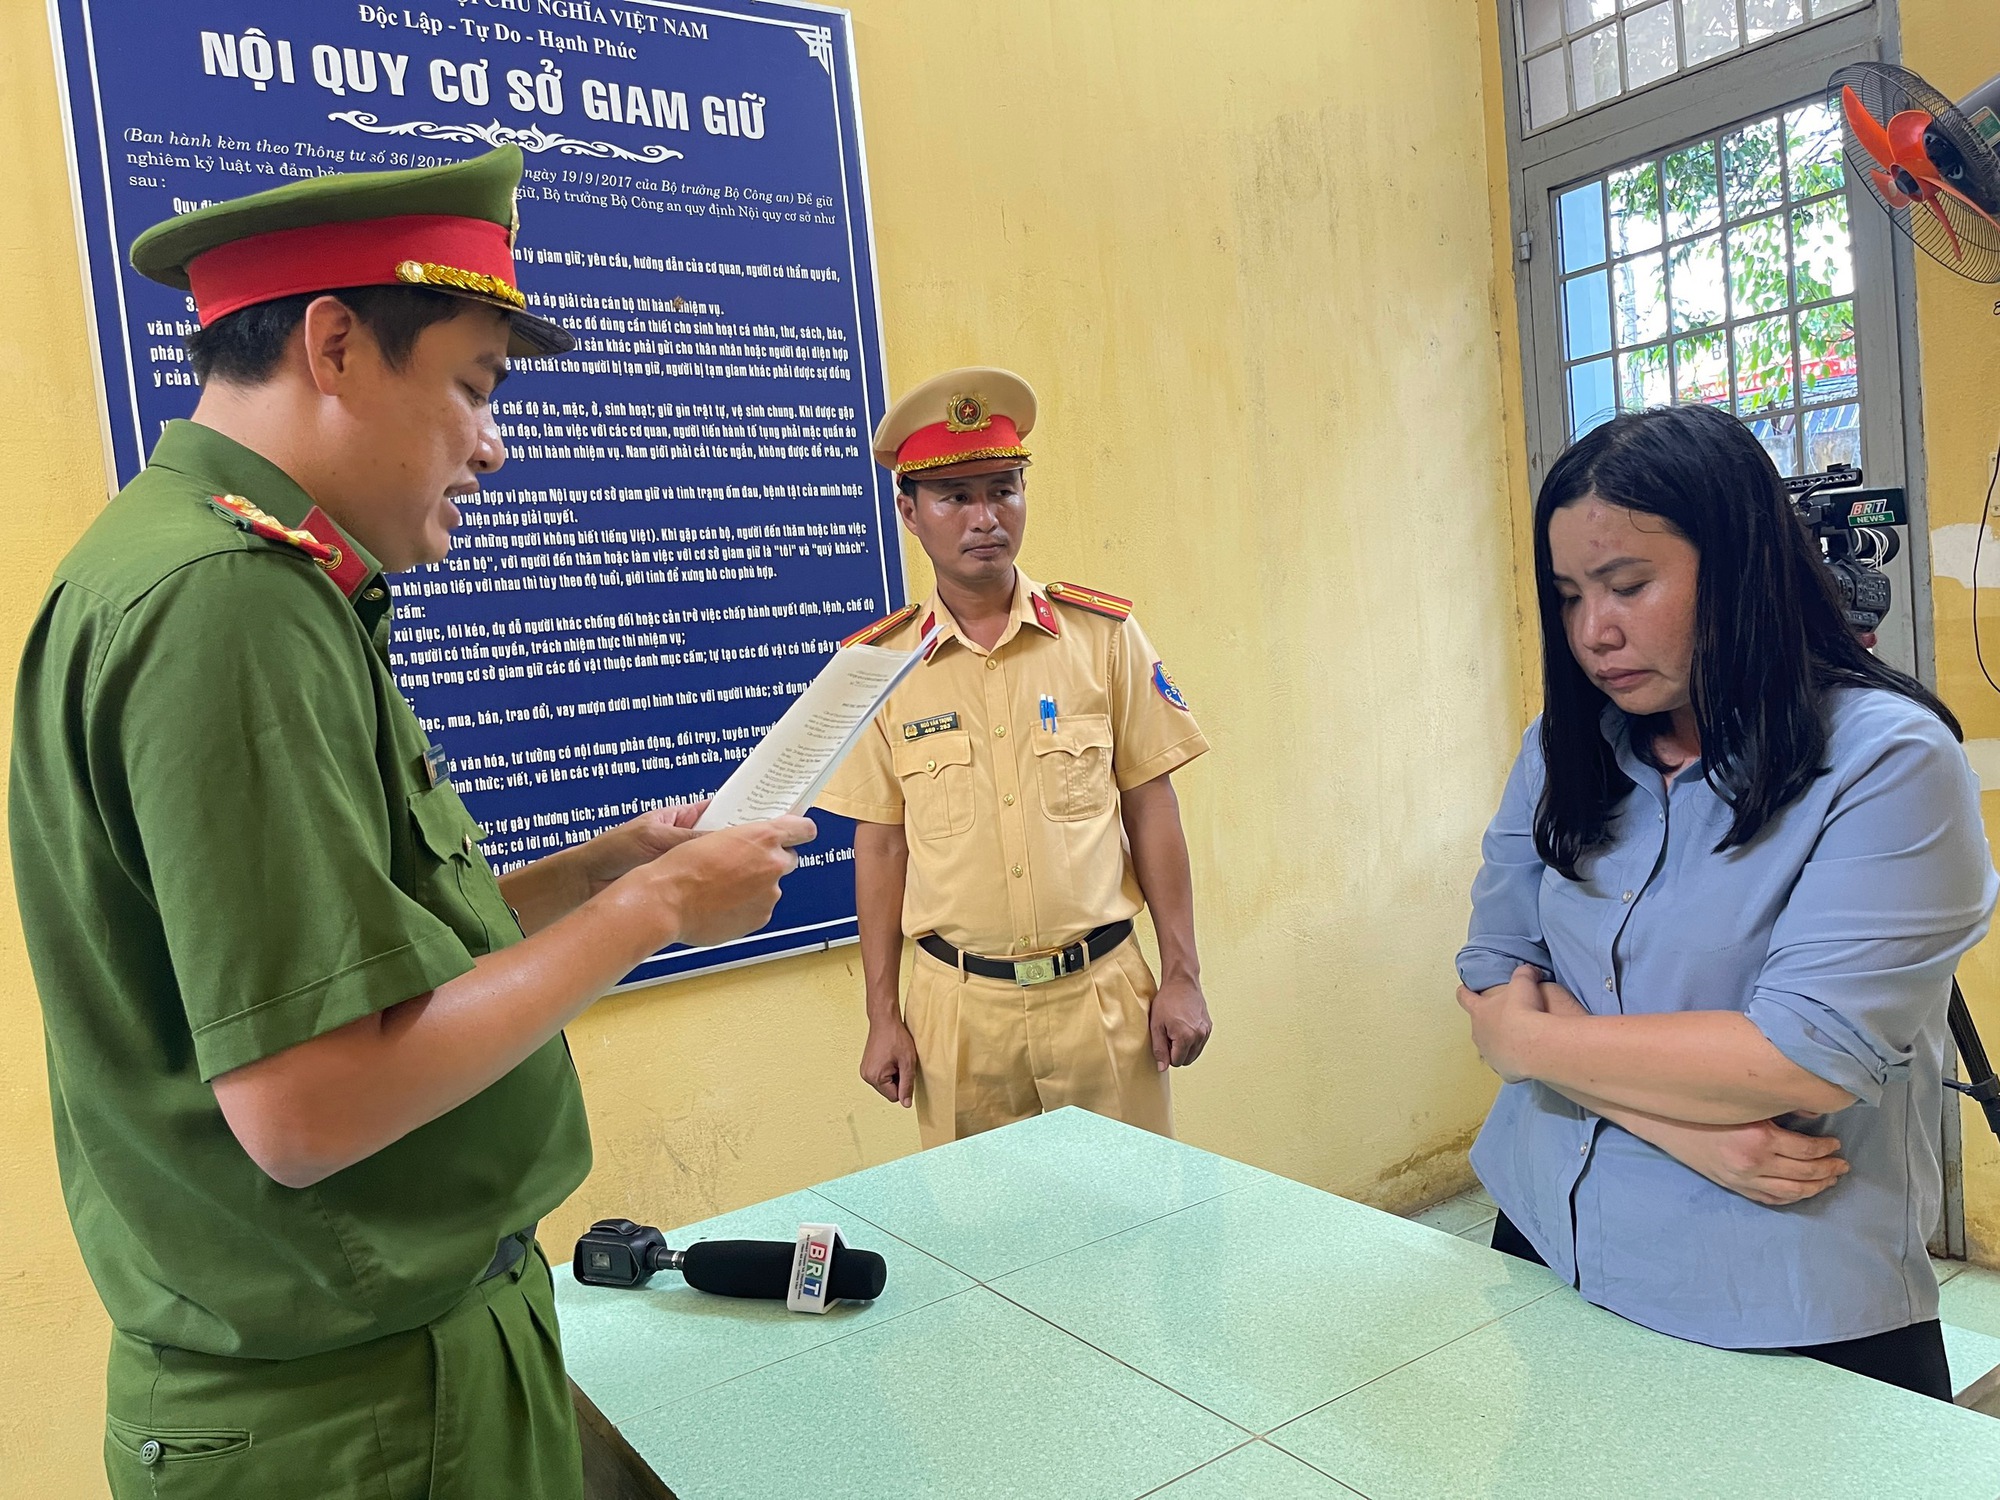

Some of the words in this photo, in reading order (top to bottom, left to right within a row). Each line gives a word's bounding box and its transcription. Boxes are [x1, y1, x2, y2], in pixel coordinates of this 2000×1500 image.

[358, 4, 398, 29] Độc
[403, 10, 443, 36] Lập
[460, 18, 490, 42] Tự
[494, 23, 521, 43] Do
[538, 29, 588, 54] Hạnh
[592, 37, 637, 60] Phúc
[609, 9, 659, 34] VIỆT
[662, 17, 709, 40] NAM
[201, 27, 296, 92] NỘI
[311, 44, 409, 97] QUY
[429, 58, 489, 107] CƠ
[506, 58, 564, 116] SỞ
[582, 78, 690, 132] GIAM
[702, 92, 766, 140] GIỮ
[124, 127, 164, 144] (Ban
[169, 131, 212, 148] hành
[217, 135, 251, 151] kèm
[256, 139, 290, 154] theo
[294, 142, 345, 163] Thông
[349, 149, 367, 162] tư
[369, 150, 386, 164] số
[126, 151, 191, 168] nghiêm
[194, 154, 214, 173] kỷ
[218, 156, 252, 175] luật
[255, 161, 275, 175] và
[279, 162, 315, 179] đảm
[129, 175, 158, 188] sau
[524, 168, 557, 184] ngày
[562, 170, 632, 188] 19/9/2017
[635, 178, 658, 191] của
[661, 180, 678, 196] Bộ
[681, 183, 721, 200] trưởng
[724, 186, 740, 201] Bộ
[743, 188, 773, 204] Công
[775, 193, 794, 204] an)
[796, 192, 812, 205] Để
[816, 195, 833, 208] giữ
[542, 186, 561, 203] Bộ
[564, 190, 608, 208] trưởng
[610, 193, 628, 210] Bộ
[631, 195, 664, 213] Công
[666, 202, 682, 212] an
[684, 204, 706, 216] quy
[708, 202, 736, 218] định
[738, 205, 759, 220] Nội
[762, 210, 782, 223] quy
[784, 212, 797, 222] cơ
[799, 211, 811, 223] sở
[814, 212, 836, 224] như
[526, 291, 541, 306] và
[542, 292, 557, 309] áp
[558, 292, 579, 309] giải
[580, 293, 600, 309] của
[601, 296, 621, 310] cán
[621, 297, 635, 314] bộ
[636, 298, 651, 312] thi
[708, 304, 724, 318] vụ.
[147, 320, 174, 336] văn
[150, 345, 184, 364] pháp
[154, 369, 162, 388] ý
[166, 368, 191, 386] của
[465, 512, 491, 529] biện
[492, 510, 520, 528] pháp
[520, 509, 542, 526] giải
[543, 508, 578, 526] quyết.
[1853, 502, 1883, 515] BRT
[1857, 515, 1885, 523] NEWS
[402, 581, 422, 596] khi
[423, 580, 448, 598] giao
[450, 578, 473, 595] tiếp
[494, 577, 521, 592] nhau
[522, 575, 538, 590] thì
[538, 575, 557, 590] tùy
[559, 574, 583, 588] theo
[584, 572, 598, 590] độ
[599, 569, 624, 587] tuổi,
[625, 570, 645, 586] giới
[646, 569, 666, 584] tính
[666, 566, 679, 582] để
[681, 568, 705, 583] xưng
[705, 567, 718, 580] hô
[719, 566, 737, 580] cho
[738, 565, 755, 581] phù
[756, 565, 777, 580] hợp.
[396, 606, 426, 620] cấm:
[410, 648, 443, 666] người
[444, 646, 458, 661] có
[460, 642, 490, 660] thẩm
[491, 640, 529, 660] quyền,
[530, 639, 562, 654] trách
[563, 637, 596, 654] nhiệm
[596, 635, 621, 651] thực
[622, 634, 636, 648] thi
[637, 632, 668, 648] nhiệm
[669, 632, 686, 646] vụ;
[419, 717, 445, 733] bạc,
[447, 714, 476, 728] mua,
[477, 710, 503, 725] bán,
[505, 708, 530, 722] trao
[532, 702, 554, 720] đổi,
[556, 704, 575, 718] vay
[577, 700, 606, 716] mượn
[608, 697, 630, 712] dưới
[632, 695, 651, 711] mọi
[652, 693, 674, 708] hình
[676, 691, 698, 705] thức
[700, 689, 716, 703] với
[717, 686, 744, 702] người
[744, 684, 771, 698] khác;
[772, 681, 784, 696] sử
[460, 756, 482, 771] văn
[483, 753, 509, 768] hóa,
[511, 751, 523, 765] tư
[525, 747, 556, 764] tưởng
[558, 745, 572, 760] có
[574, 743, 592, 760] nội
[592, 742, 618, 756] dung
[620, 736, 645, 754] phản
[646, 735, 675, 752] động,
[677, 730, 693, 746] đồi
[694, 731, 720, 745] trụy,
[722, 726, 750, 742] tuyên
[510, 837, 524, 852] có
[526, 835, 541, 850] lời
[542, 832, 564, 848] nói,
[798, 853, 824, 868] khác;
[804, 1243, 827, 1297] BRT
